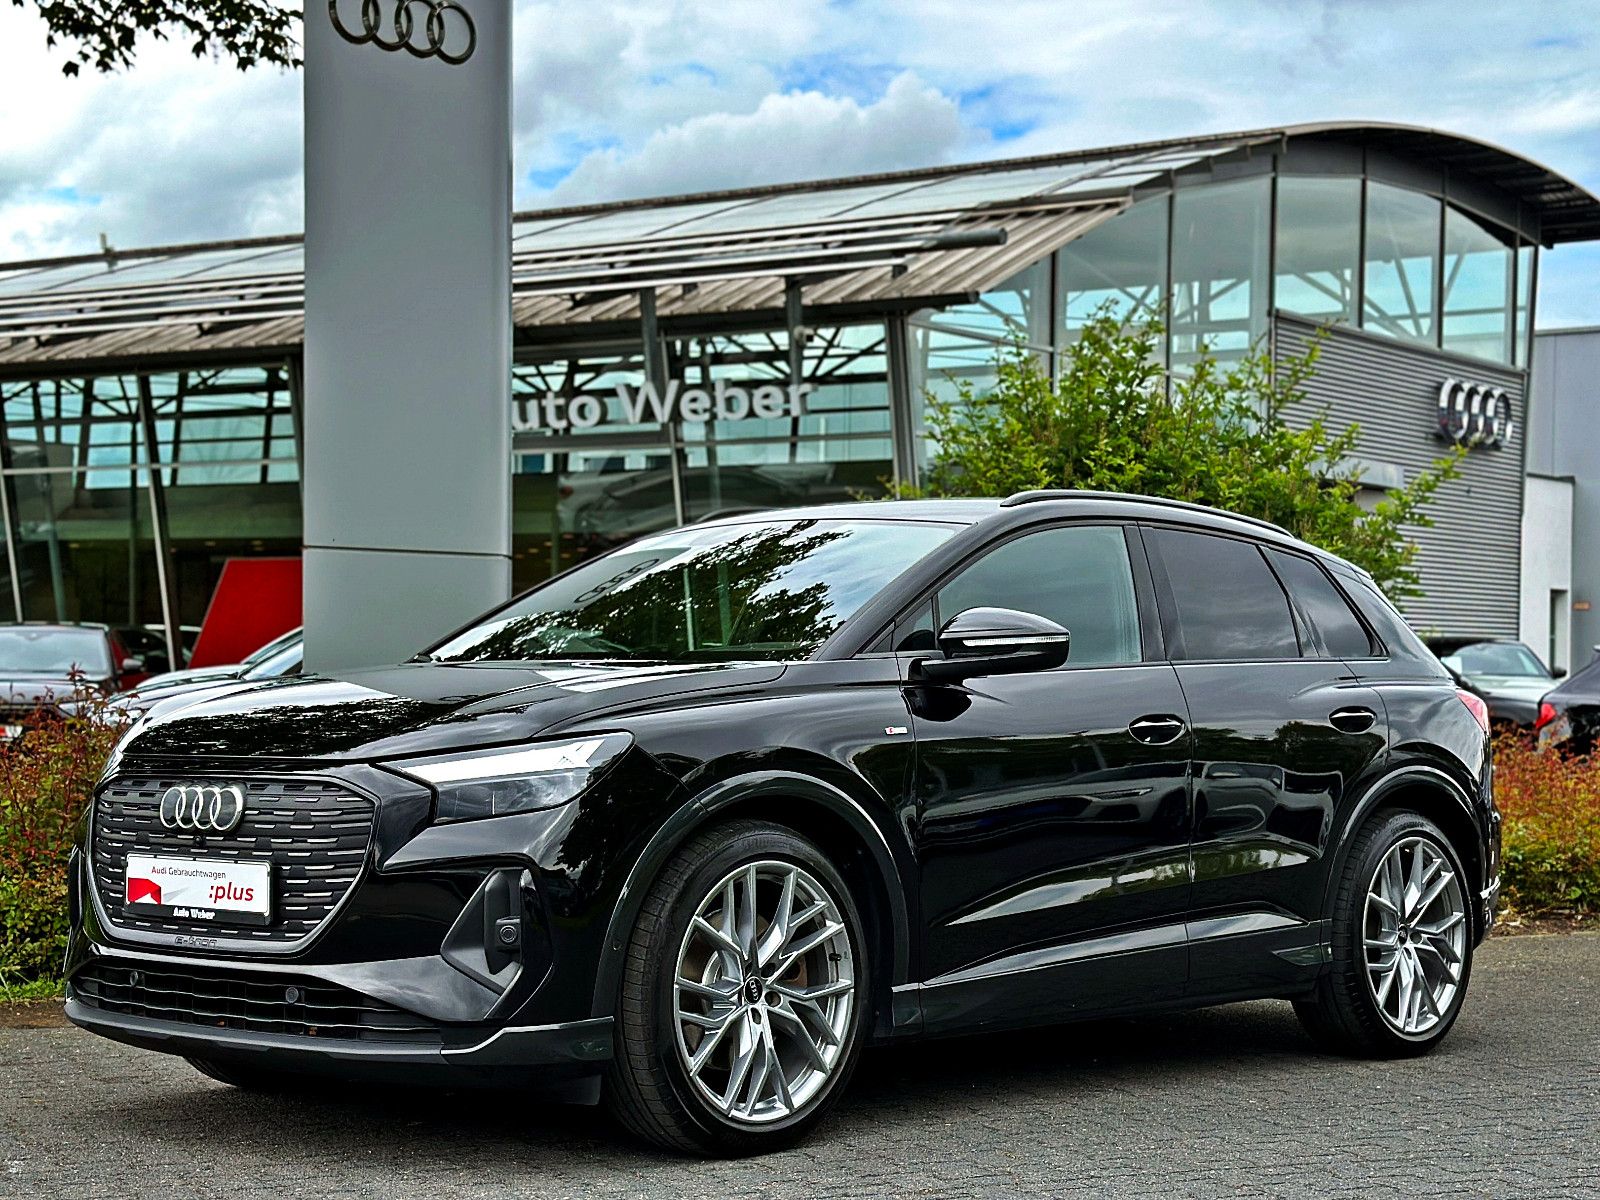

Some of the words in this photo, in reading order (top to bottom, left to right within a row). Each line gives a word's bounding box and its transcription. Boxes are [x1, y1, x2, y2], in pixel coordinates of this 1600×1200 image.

[512, 391, 601, 429] uto
[615, 378, 815, 424] Weber
[151, 866, 167, 875] Audi
[168, 867, 226, 880] Gebrauchtwagen
[208, 881, 254, 903] :plus
